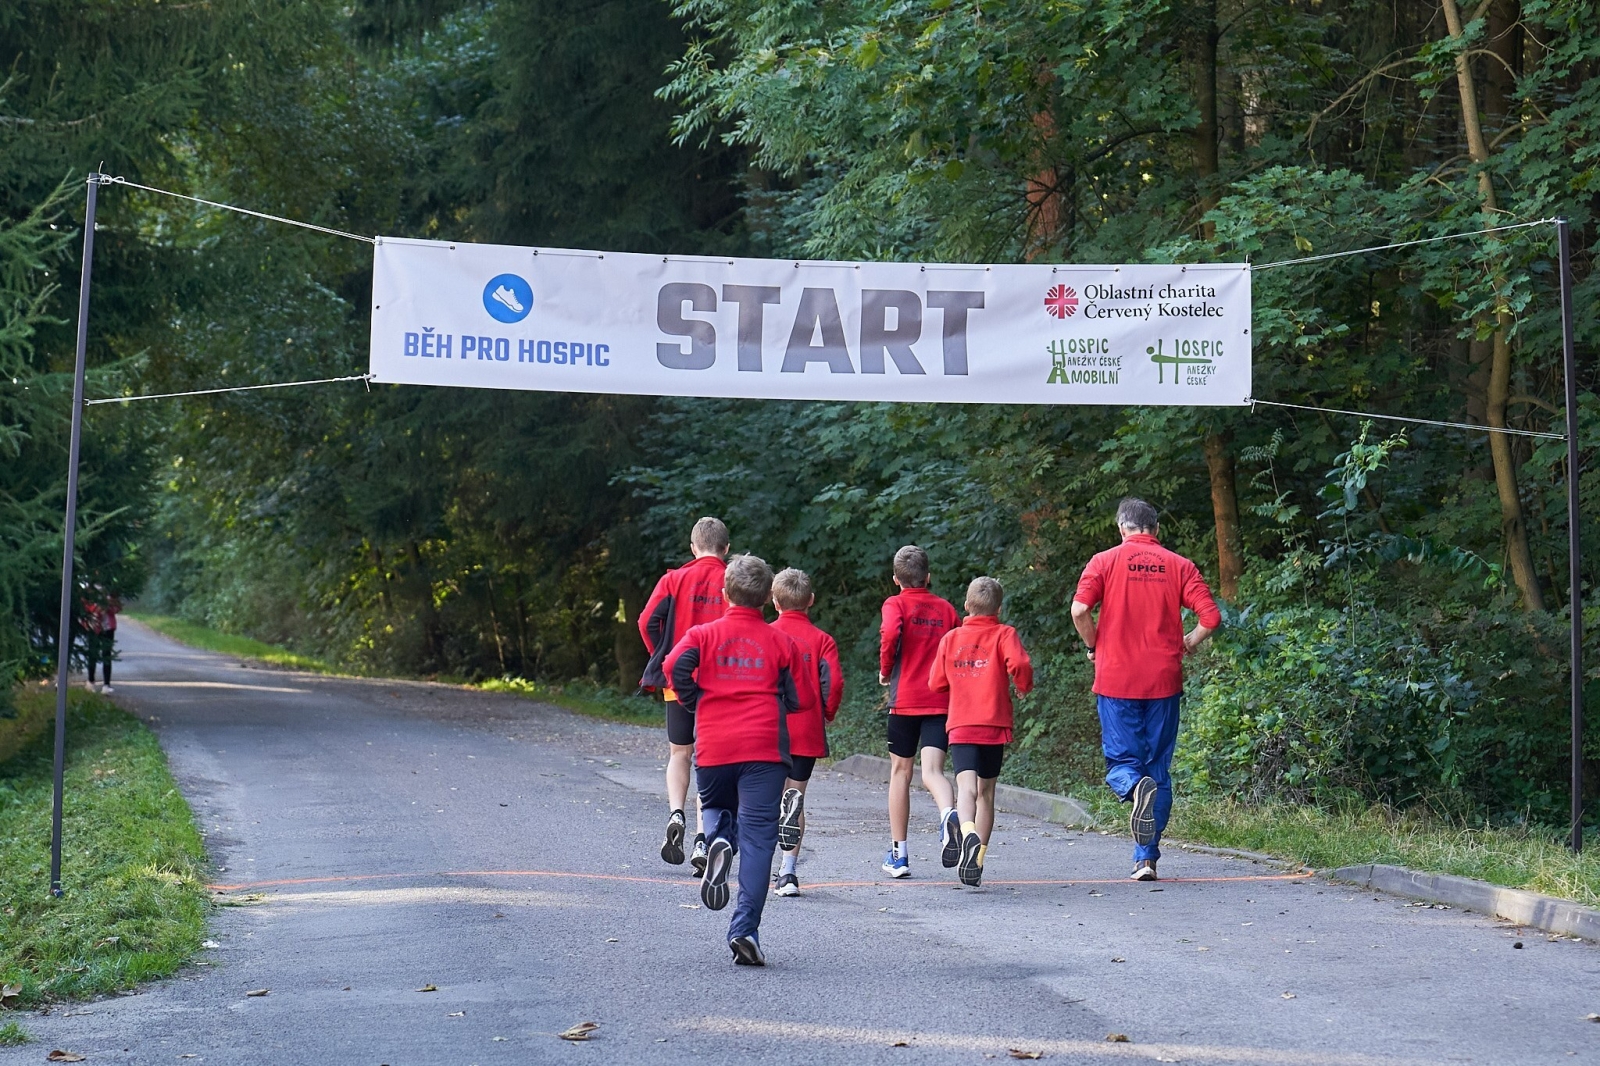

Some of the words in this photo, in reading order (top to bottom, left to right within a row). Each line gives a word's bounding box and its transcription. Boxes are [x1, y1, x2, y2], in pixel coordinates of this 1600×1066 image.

[1084, 284, 1154, 300] Oblastní
[1159, 284, 1216, 298] charita
[1084, 301, 1152, 321] Červený
[1158, 302, 1224, 317] Kostelec
[656, 282, 985, 376] START
[404, 326, 453, 359] BĚH
[460, 335, 510, 362] PRO
[518, 339, 610, 367] HOSPIC
[1071, 368, 1122, 384] MOBILNÍ
